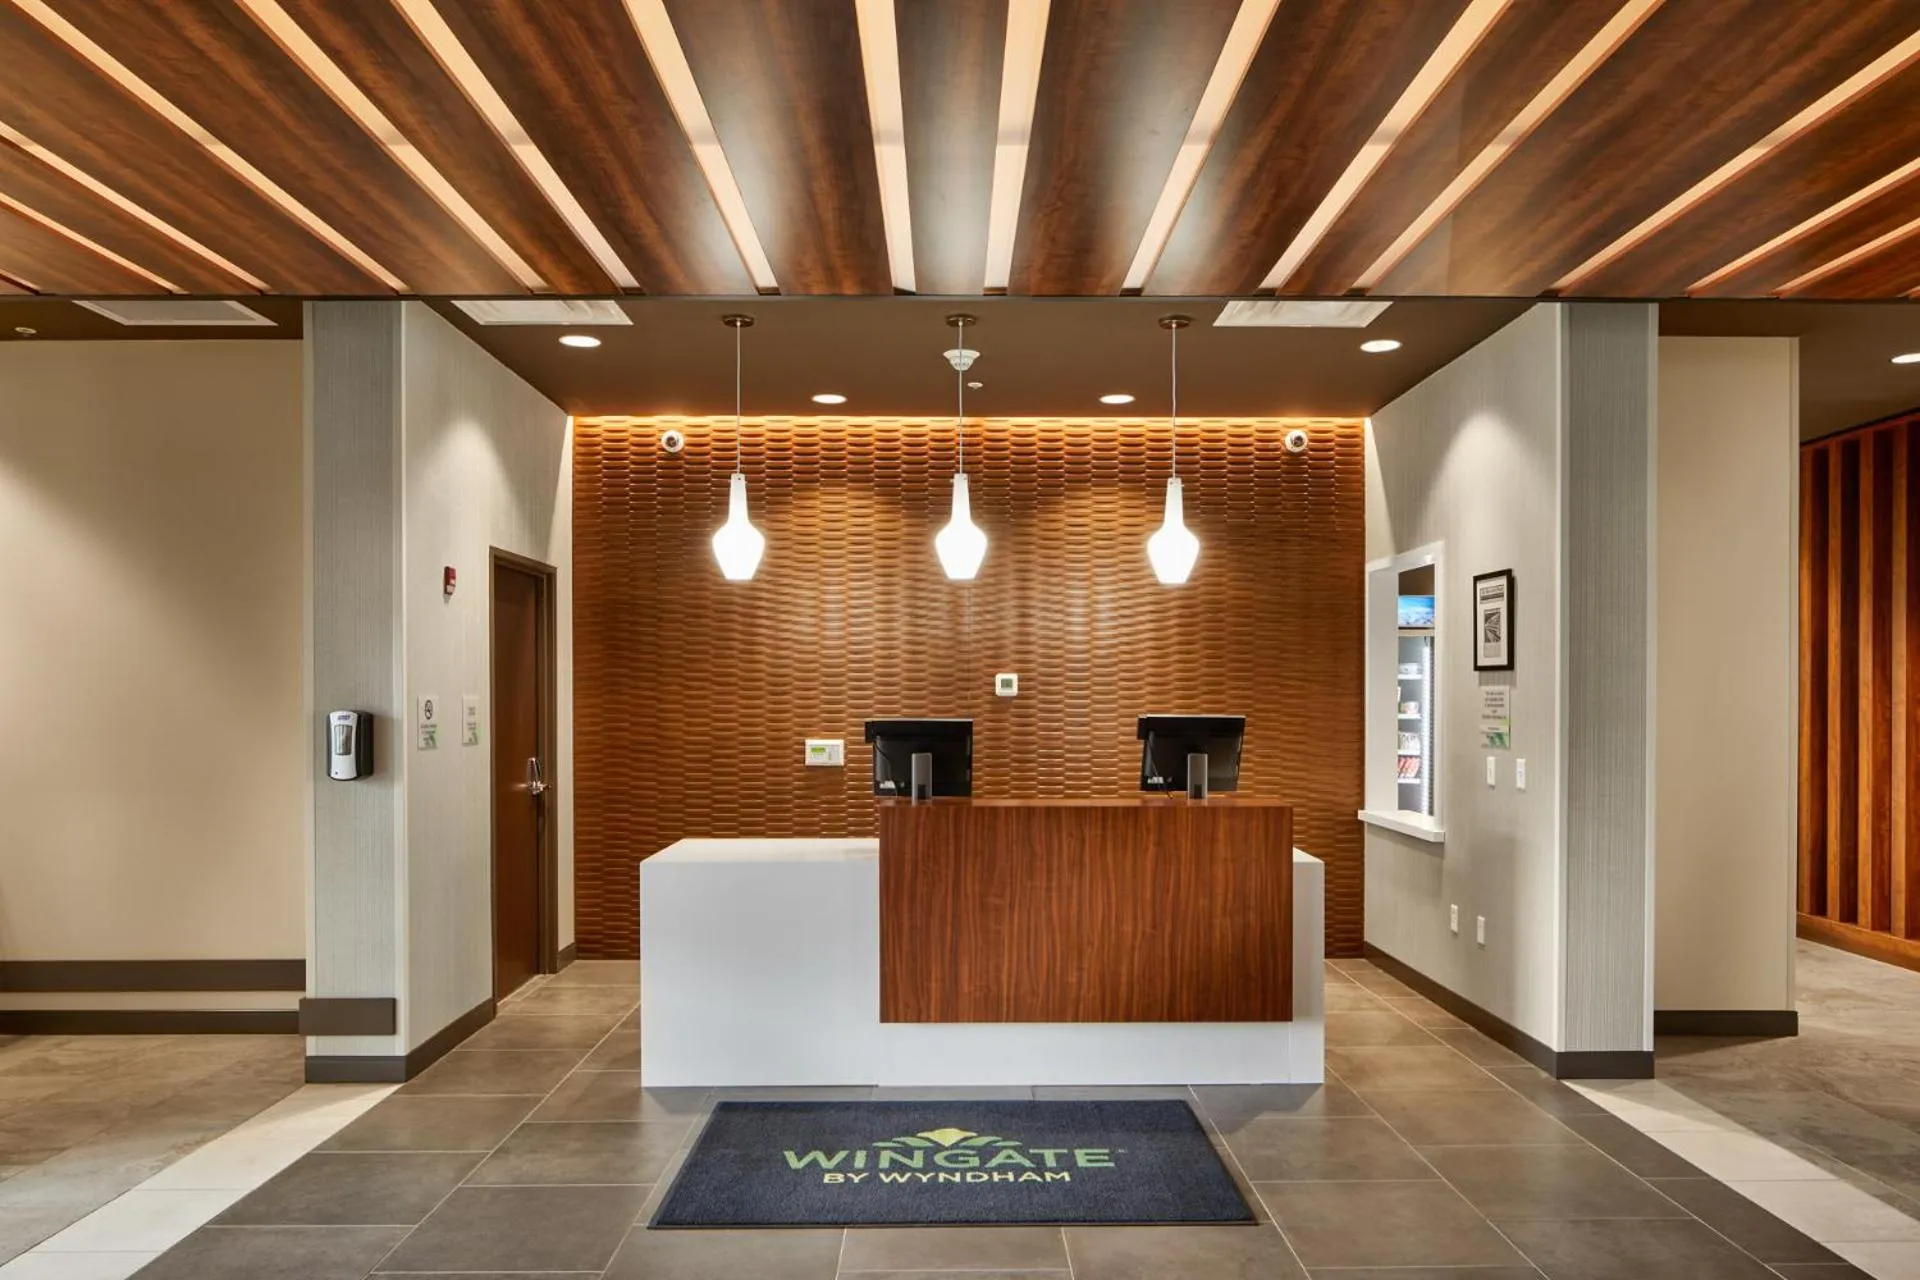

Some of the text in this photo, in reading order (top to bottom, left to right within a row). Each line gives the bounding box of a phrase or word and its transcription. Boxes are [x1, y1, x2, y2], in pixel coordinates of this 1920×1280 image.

[783, 1148, 1115, 1170] WINGATE
[823, 1171, 1071, 1184] BY WYNDHAM
